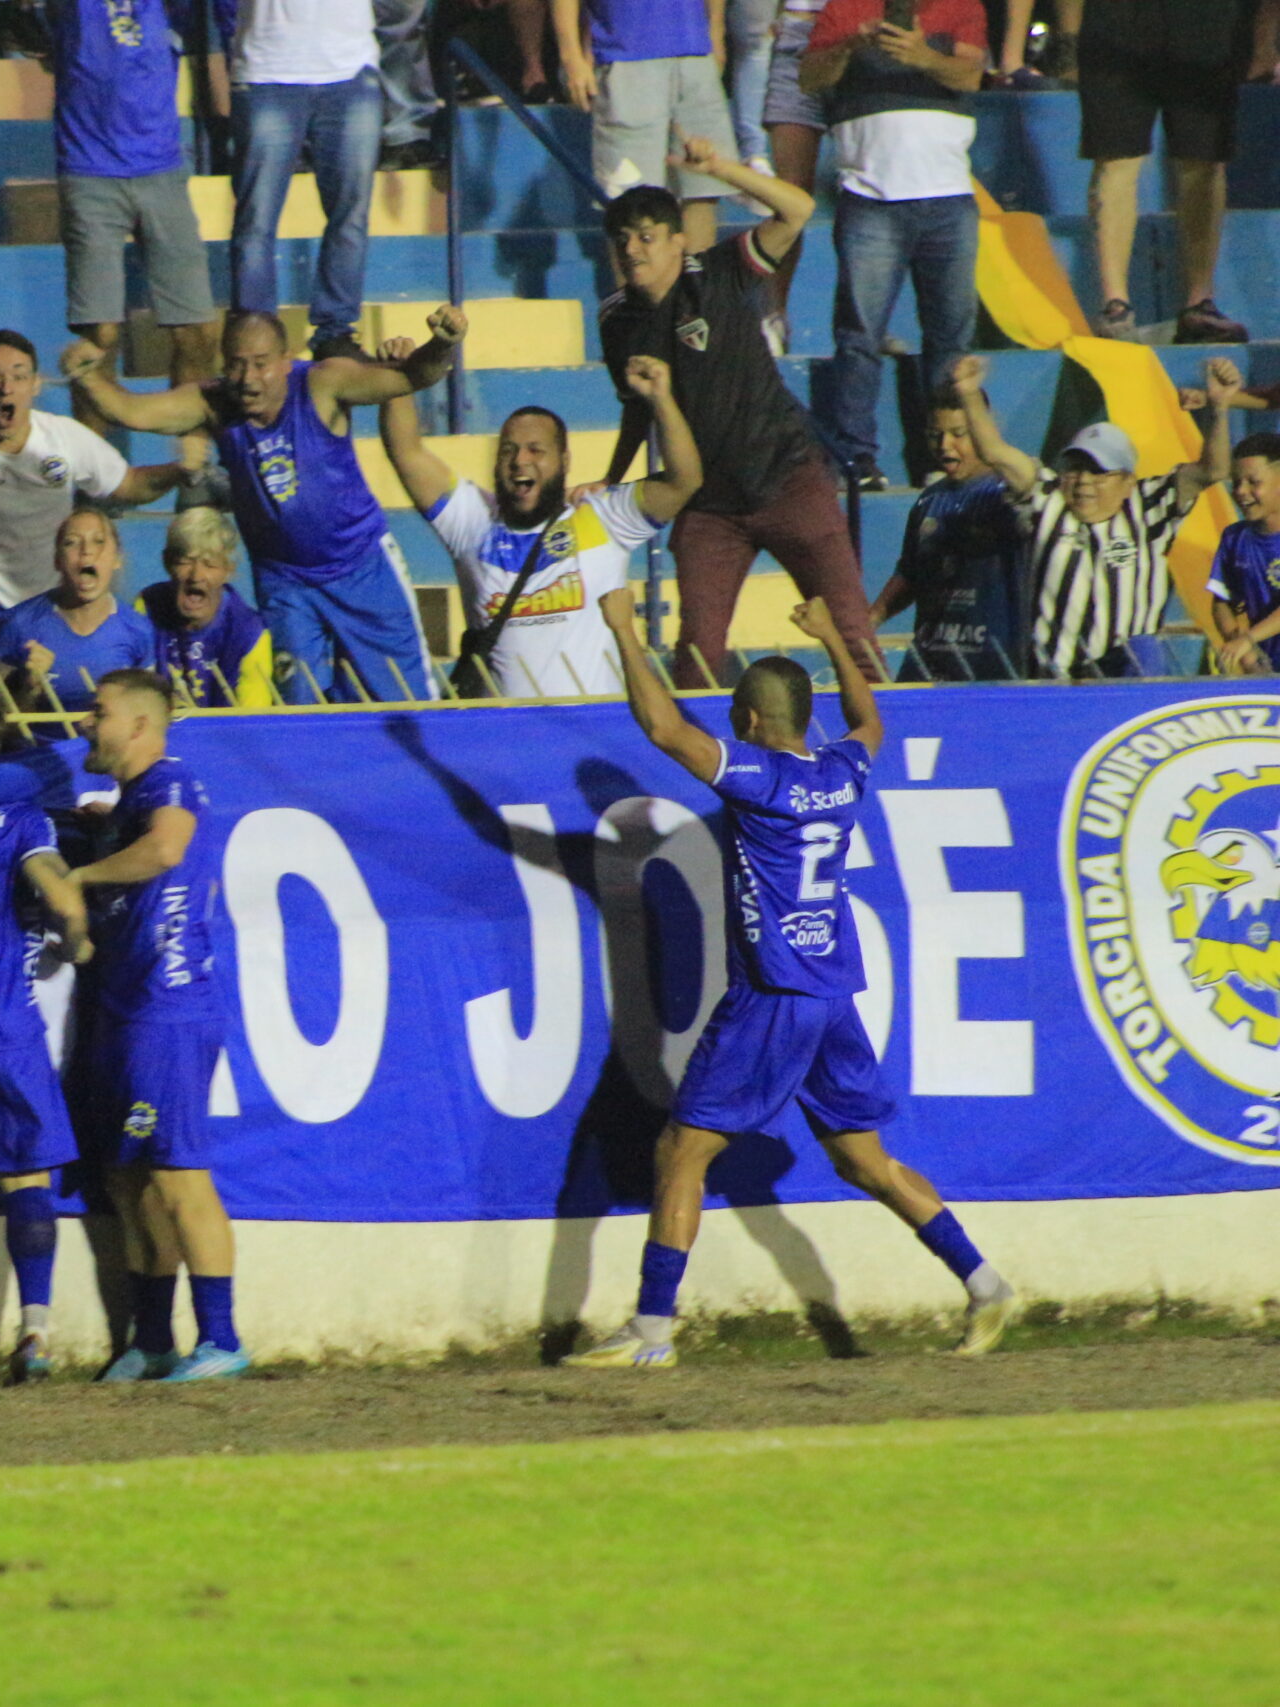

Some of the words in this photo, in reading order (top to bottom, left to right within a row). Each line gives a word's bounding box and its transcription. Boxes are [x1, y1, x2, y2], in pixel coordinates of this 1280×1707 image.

[1081, 707, 1280, 839] UNIFORMIZ
[797, 821, 842, 902] 2
[162, 885, 194, 989] INOVAR
[1079, 853, 1181, 1084] TORCIDA
[1238, 1104, 1280, 1145] 2
